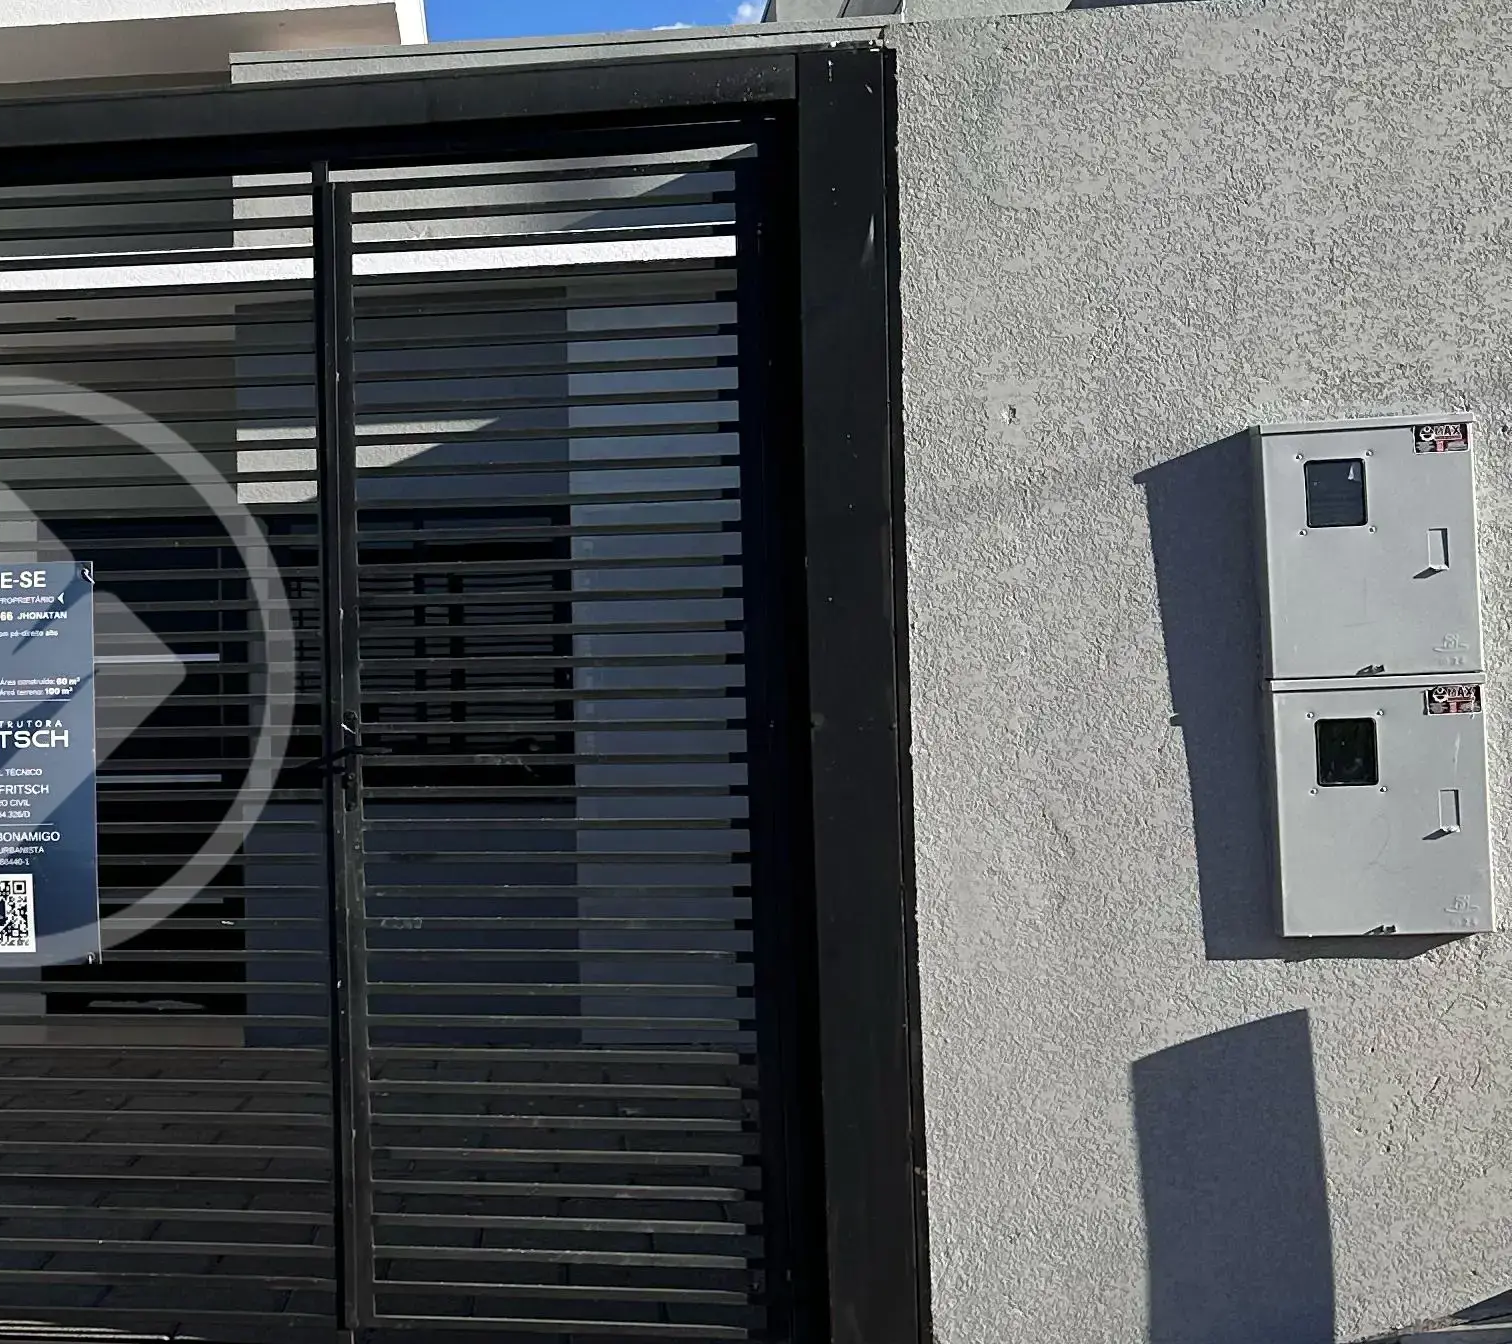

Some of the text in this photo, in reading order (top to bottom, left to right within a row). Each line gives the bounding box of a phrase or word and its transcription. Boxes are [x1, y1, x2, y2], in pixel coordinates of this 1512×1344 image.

[17, 611, 68, 620] JHONATAN
[4, 768, 43, 777] TÉCNICO
[9, 799, 31, 807] CIVIL
